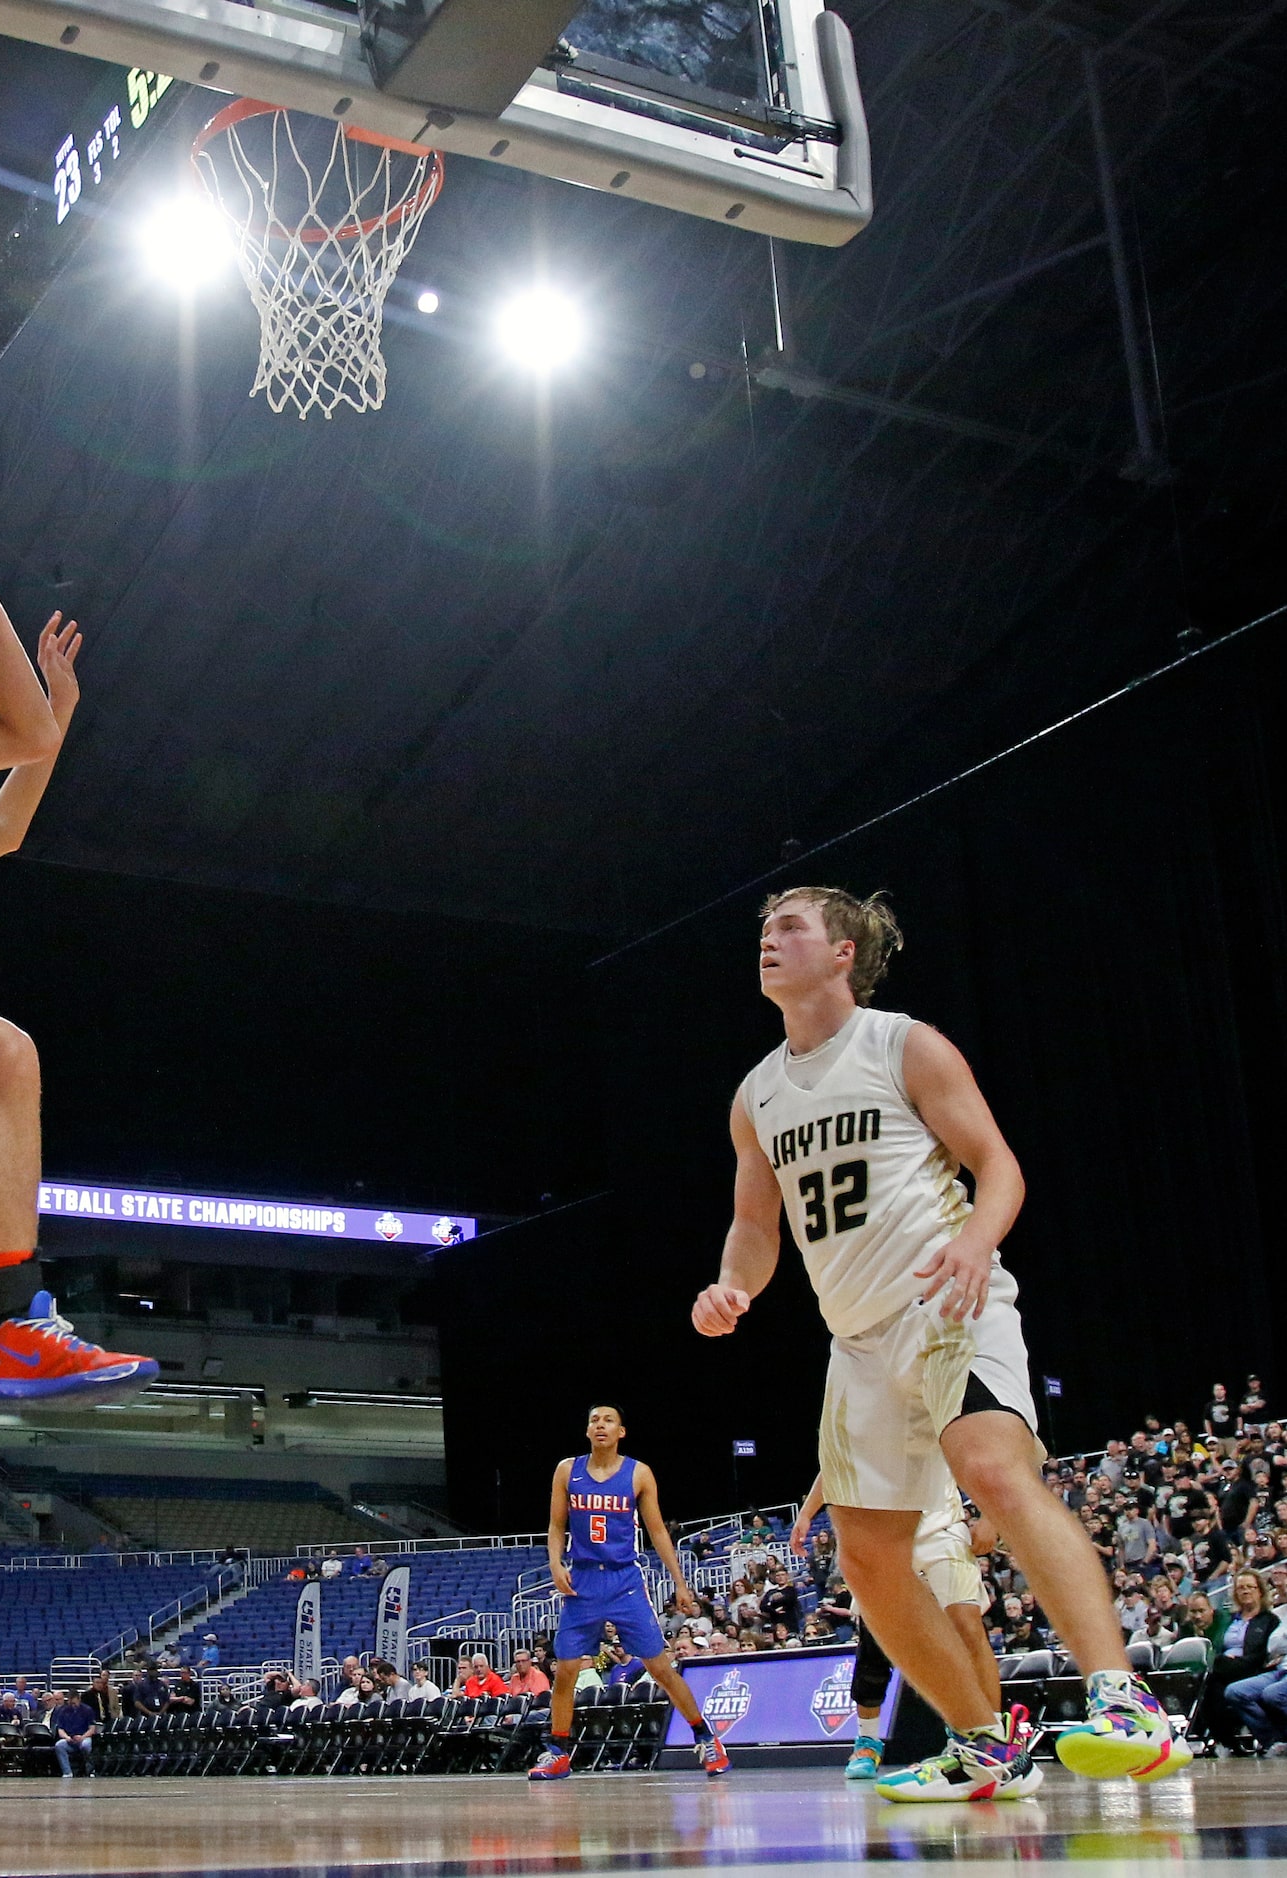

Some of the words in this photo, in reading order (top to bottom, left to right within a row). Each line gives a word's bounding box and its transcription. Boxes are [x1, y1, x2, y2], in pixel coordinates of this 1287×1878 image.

[93, 161, 102, 185] 3
[111, 134, 120, 160] 2
[54, 149, 82, 225] 23
[772, 1108, 881, 1171] JAYTON
[37, 1185, 115, 1215] ETBALL
[121, 1190, 184, 1221] STATE
[188, 1199, 346, 1234] CHAMPIONSHIPS
[798, 1159, 868, 1244] 32
[569, 1493, 630, 1513] SLIDELL
[589, 1514, 607, 1544] 5
[383, 1586, 402, 1623] UIL
[704, 1696, 749, 1714] STATE
